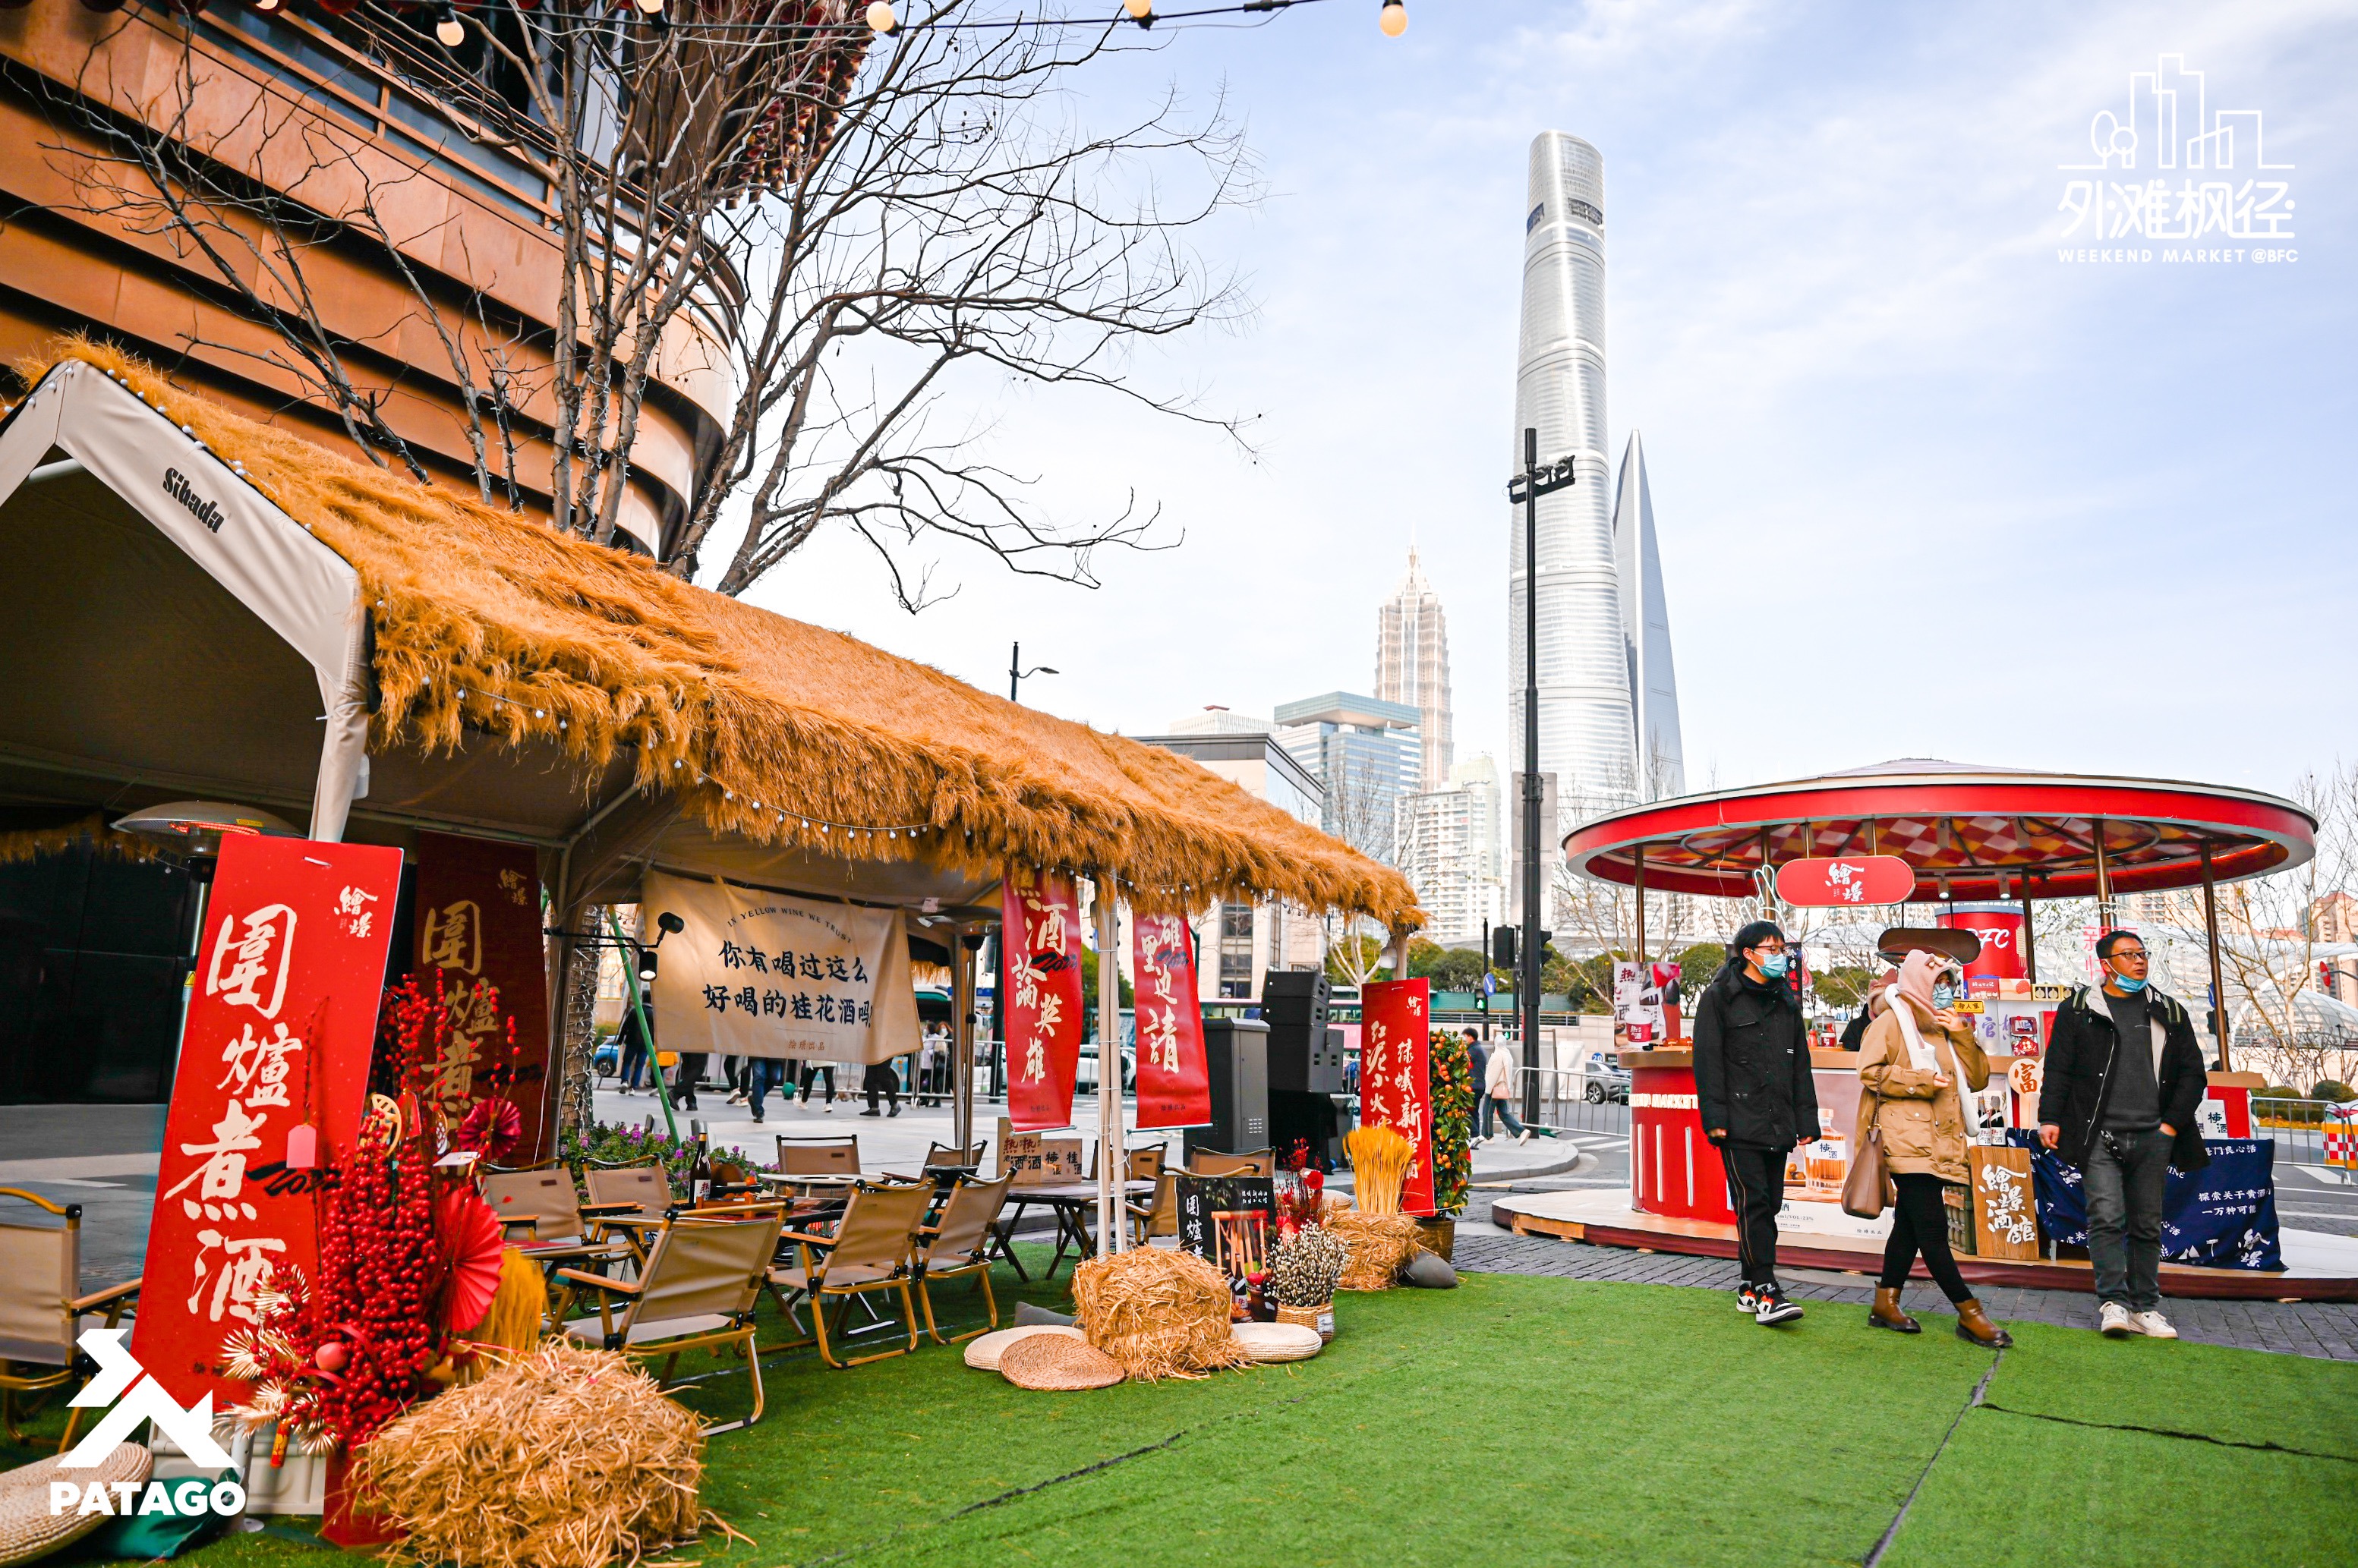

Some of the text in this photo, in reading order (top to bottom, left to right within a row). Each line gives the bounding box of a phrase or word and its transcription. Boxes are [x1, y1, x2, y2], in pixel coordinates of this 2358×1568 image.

[162, 467, 225, 534] Sibada
[727, 907, 853, 944] IN YELLOW WINE WE TRUST
[1965, 927, 2010, 949] FC
[718, 940, 868, 984] 你有喝过这么
[2014, 1063, 2038, 1094] 富
[1652, 1094, 1698, 1110] MARKET
[2202, 1205, 2256, 1216] 一万种可能
